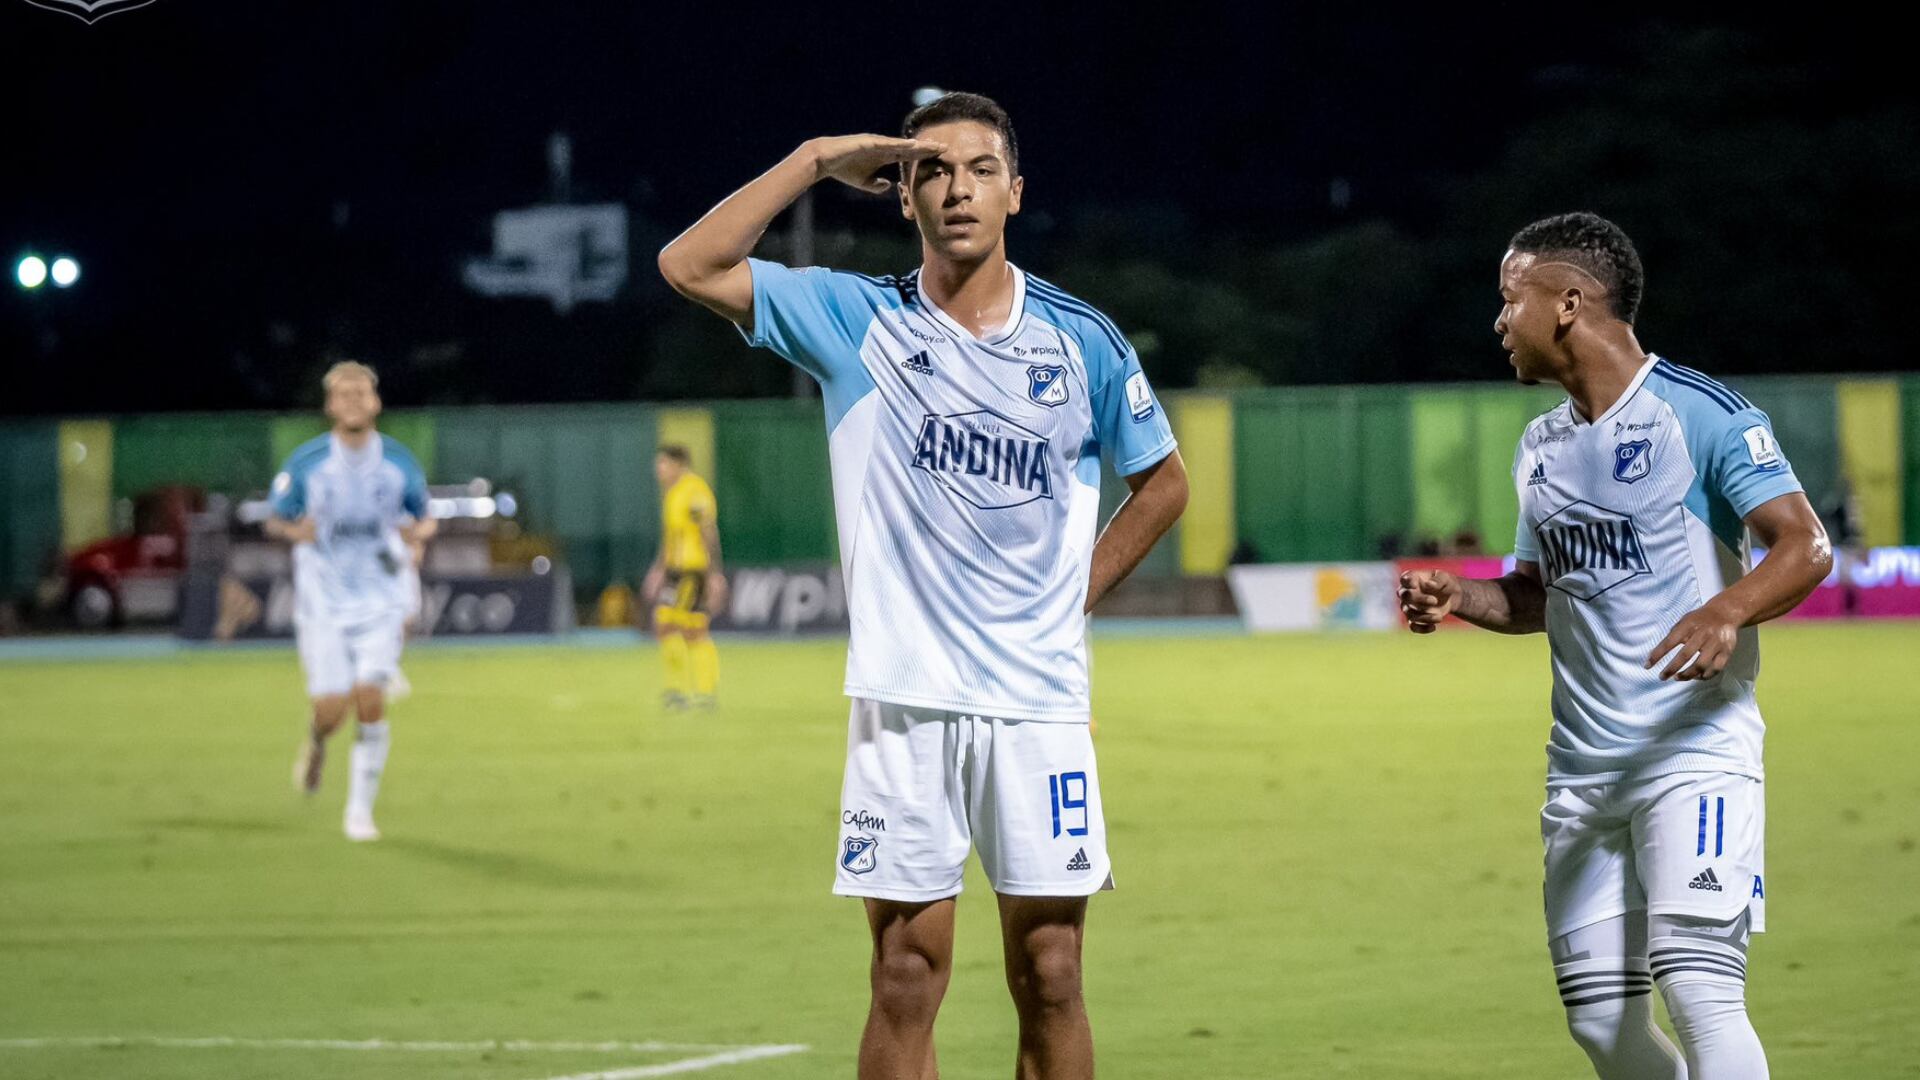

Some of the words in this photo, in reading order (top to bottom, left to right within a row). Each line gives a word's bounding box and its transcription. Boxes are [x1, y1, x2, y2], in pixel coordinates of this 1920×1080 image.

[901, 361, 934, 376] adidas
[917, 417, 1050, 495] ANDINA
[1527, 478, 1547, 486] adidas
[1539, 519, 1646, 585] ANDINA
[1049, 771, 1089, 839] 19
[1697, 795, 1724, 857] 11
[1066, 862, 1091, 871] adidas
[1688, 881, 1723, 892] adidas
